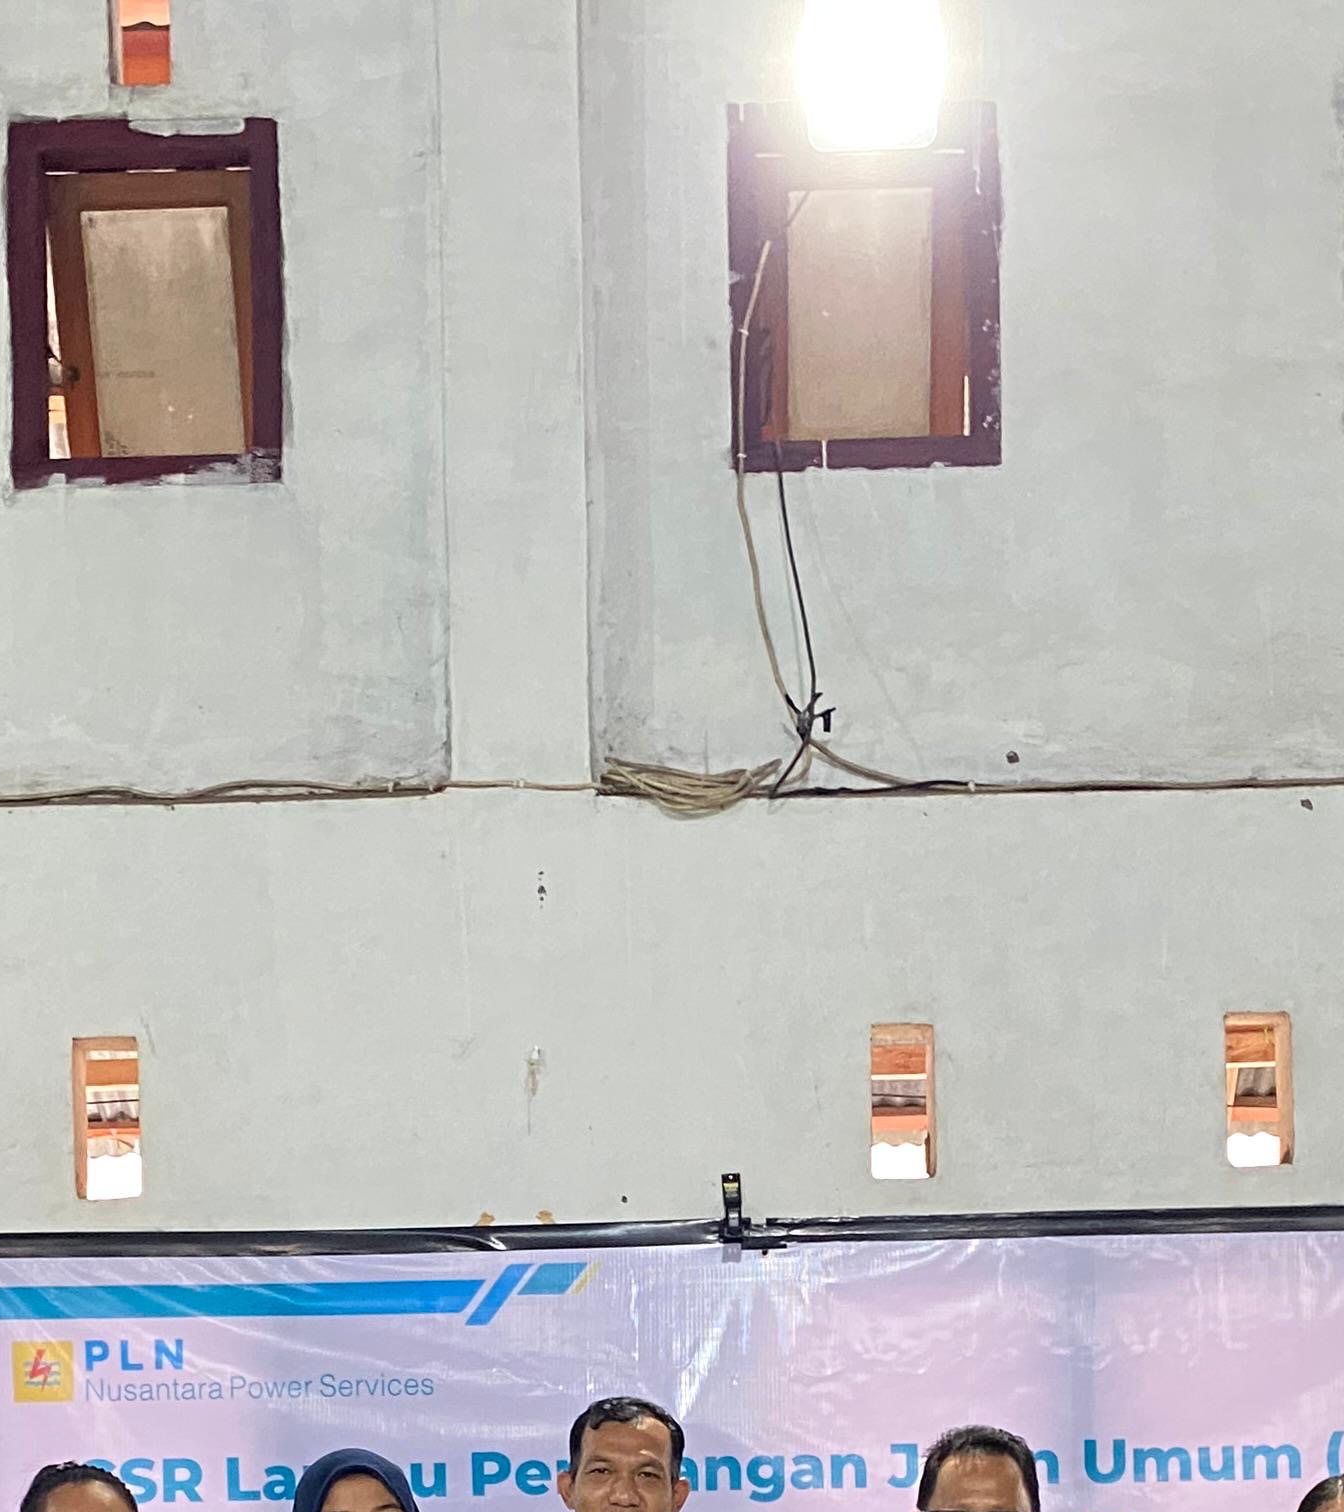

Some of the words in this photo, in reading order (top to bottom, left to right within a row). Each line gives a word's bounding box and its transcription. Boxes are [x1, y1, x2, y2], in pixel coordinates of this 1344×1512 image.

[84, 1338, 185, 1372] PLN
[84, 1377, 225, 1402] Nusantara
[229, 1375, 313, 1399] Power
[319, 1372, 436, 1398] Services
[85, 1457, 203, 1503] SR
[226, 1456, 447, 1502] Lau
[1083, 1438, 1302, 1484] Umum
